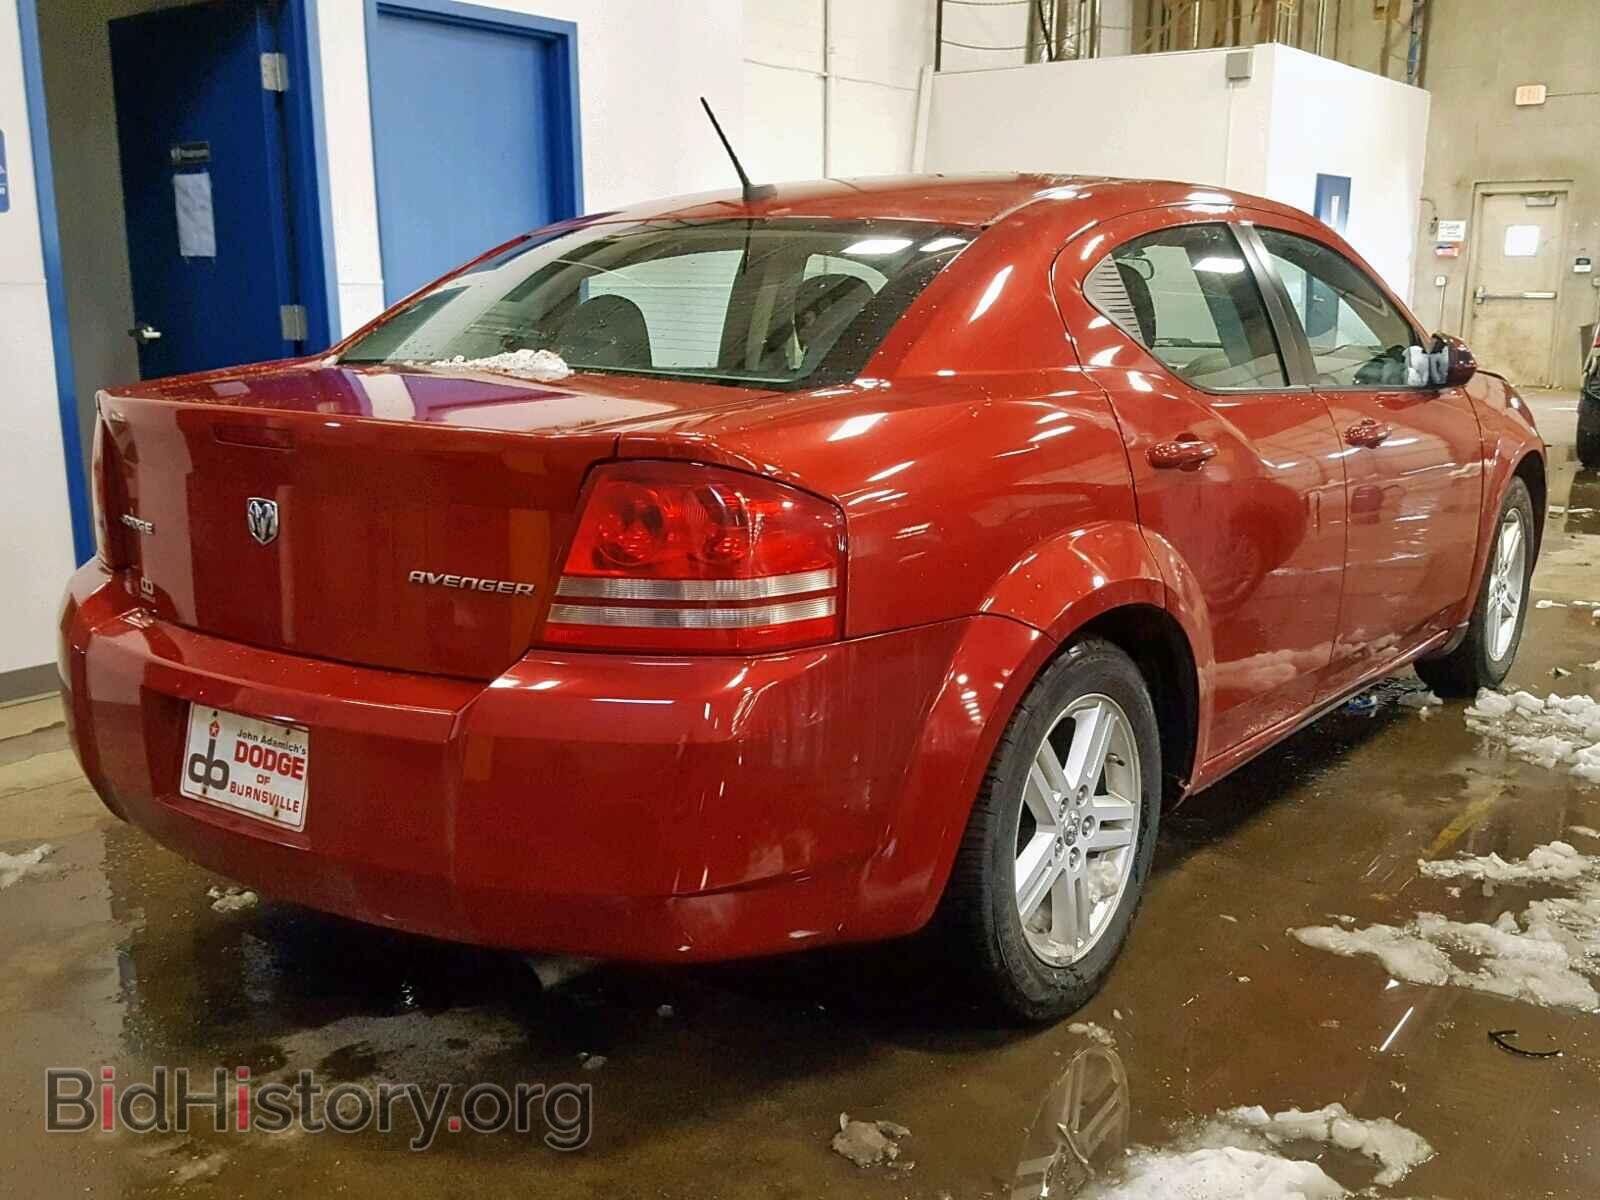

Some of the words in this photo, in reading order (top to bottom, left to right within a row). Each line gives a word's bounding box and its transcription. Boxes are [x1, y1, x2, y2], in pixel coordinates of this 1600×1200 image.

[408, 570, 536, 596] AVENGER
[236, 729, 258, 741] John
[260, 735, 306, 755] Adamich's
[234, 739, 305, 781] DODGE
[256, 774, 271, 785] OF
[229, 781, 300, 813] BURNSVILLE
